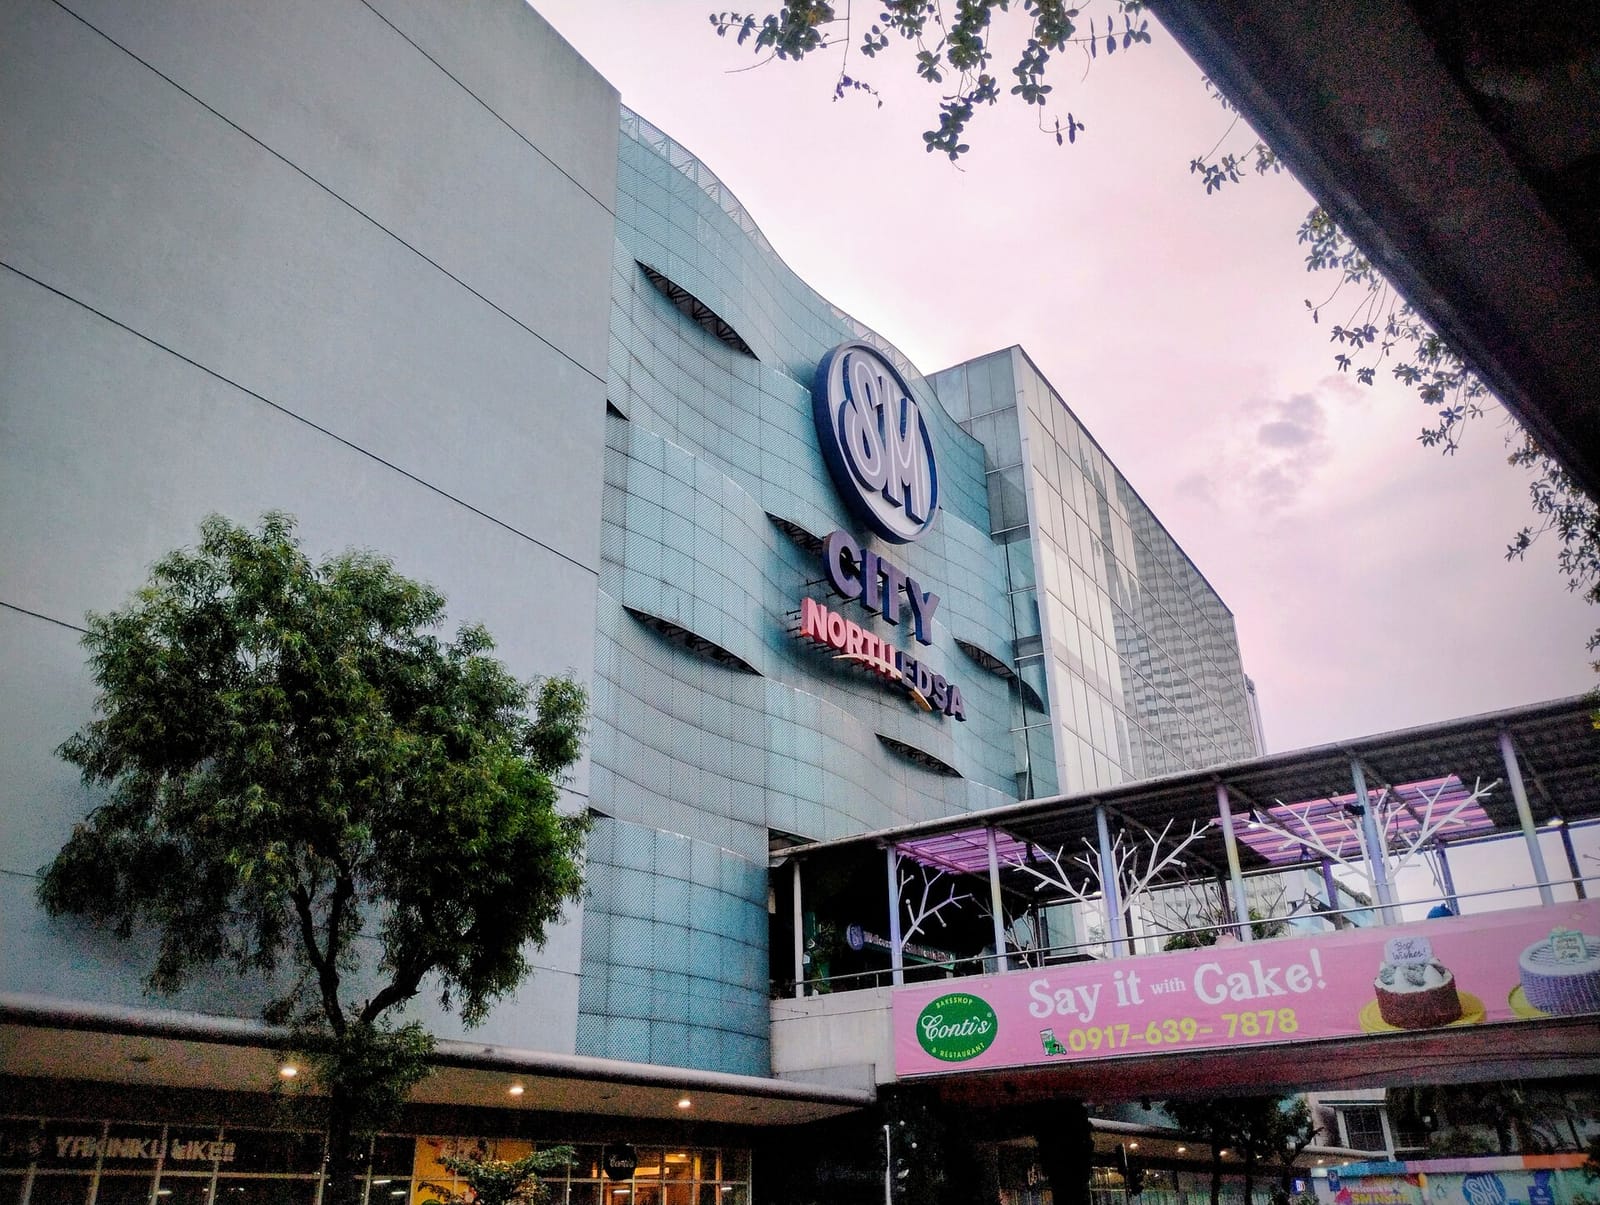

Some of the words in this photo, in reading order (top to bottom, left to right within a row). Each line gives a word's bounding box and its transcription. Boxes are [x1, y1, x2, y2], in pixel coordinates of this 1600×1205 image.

[838, 351, 925, 524] SM
[823, 529, 941, 646] CITY
[800, 597, 902, 679] NORTH
[896, 651, 967, 722] EDSA
[935, 997, 973, 1009] BAKESHOP
[1028, 976, 1102, 1023] Say
[1113, 969, 1145, 1007] it
[1150, 977, 1186, 996] with
[1193, 948, 1327, 1005] Cake!
[921, 1014, 993, 1041] Conti's
[1221, 1007, 1299, 1038] 7878
[940, 1042, 985, 1058] RESTAURANT
